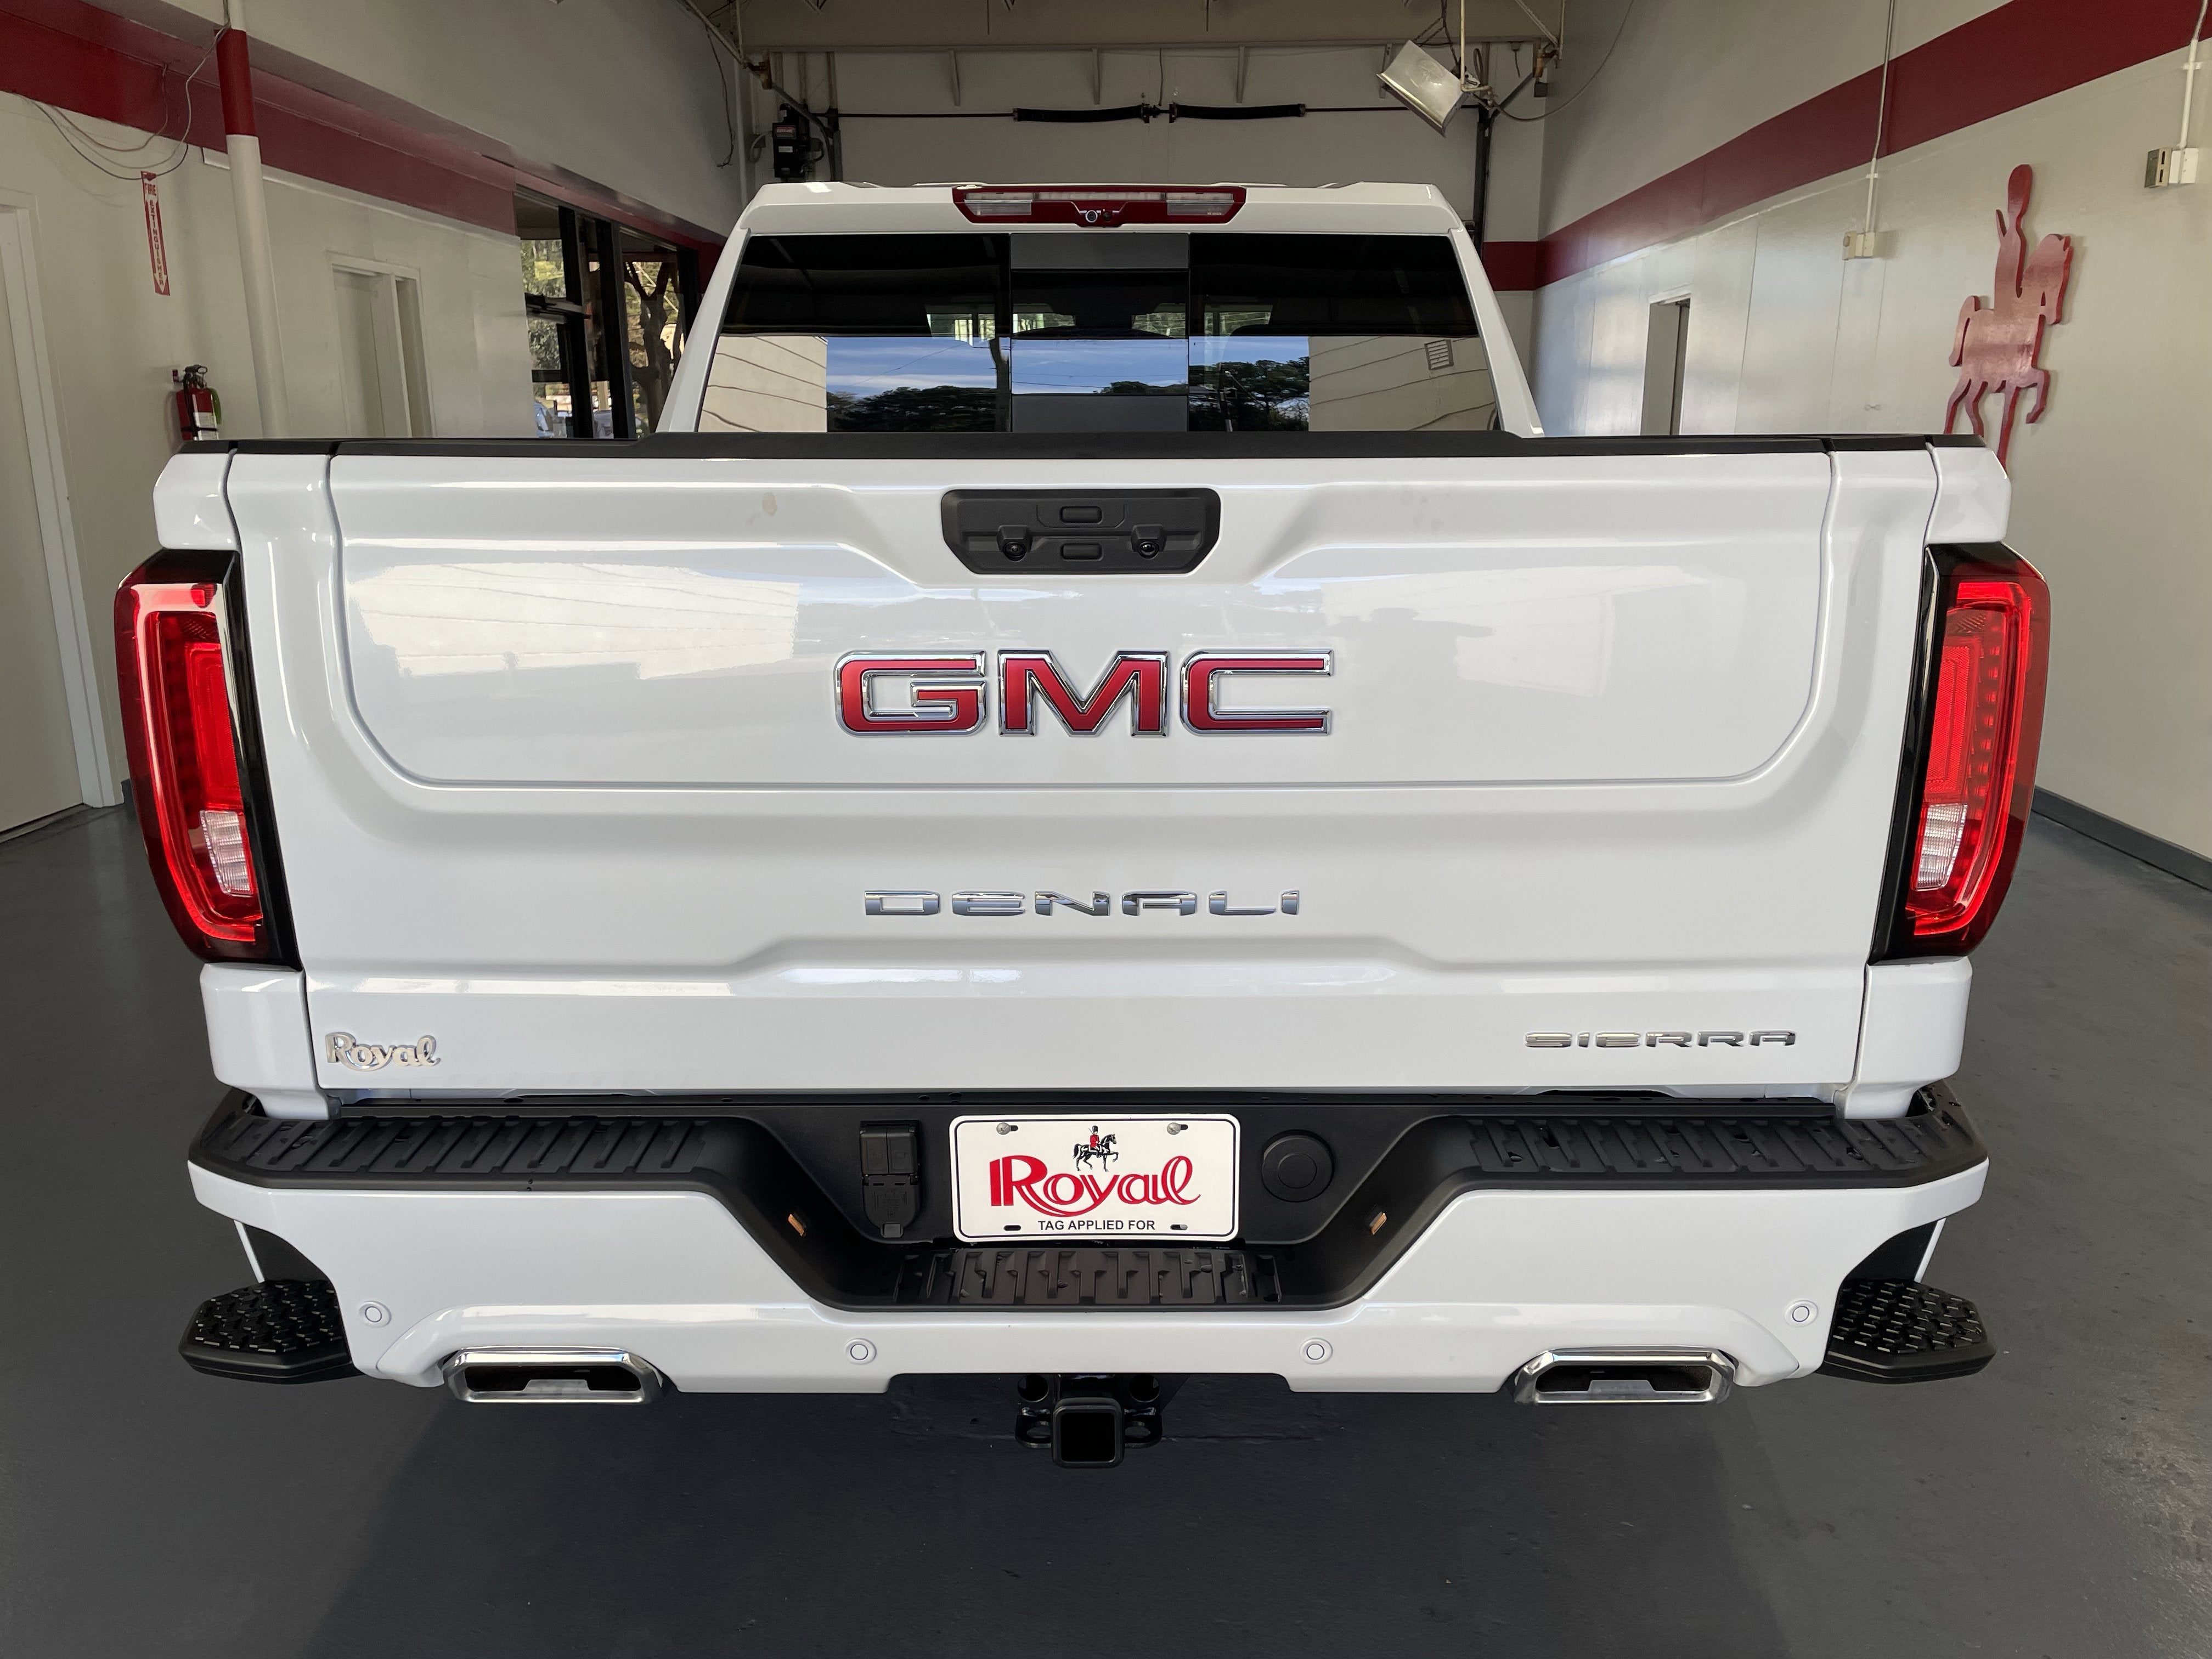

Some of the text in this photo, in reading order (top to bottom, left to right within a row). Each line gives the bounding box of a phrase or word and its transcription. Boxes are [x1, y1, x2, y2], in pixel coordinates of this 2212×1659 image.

[144, 183, 156, 196] FIRE
[150, 200, 163, 286] EXTINGUISHER
[834, 649, 1333, 737] GMC
[864, 890, 1300, 916] DENALI
[325, 1031, 441, 1071] Royal
[1525, 1031, 1796, 1047] SIERRA
[989, 1155, 1201, 1217] Royal
[1037, 1220, 1155, 1231] TAG APPLIED FOR
